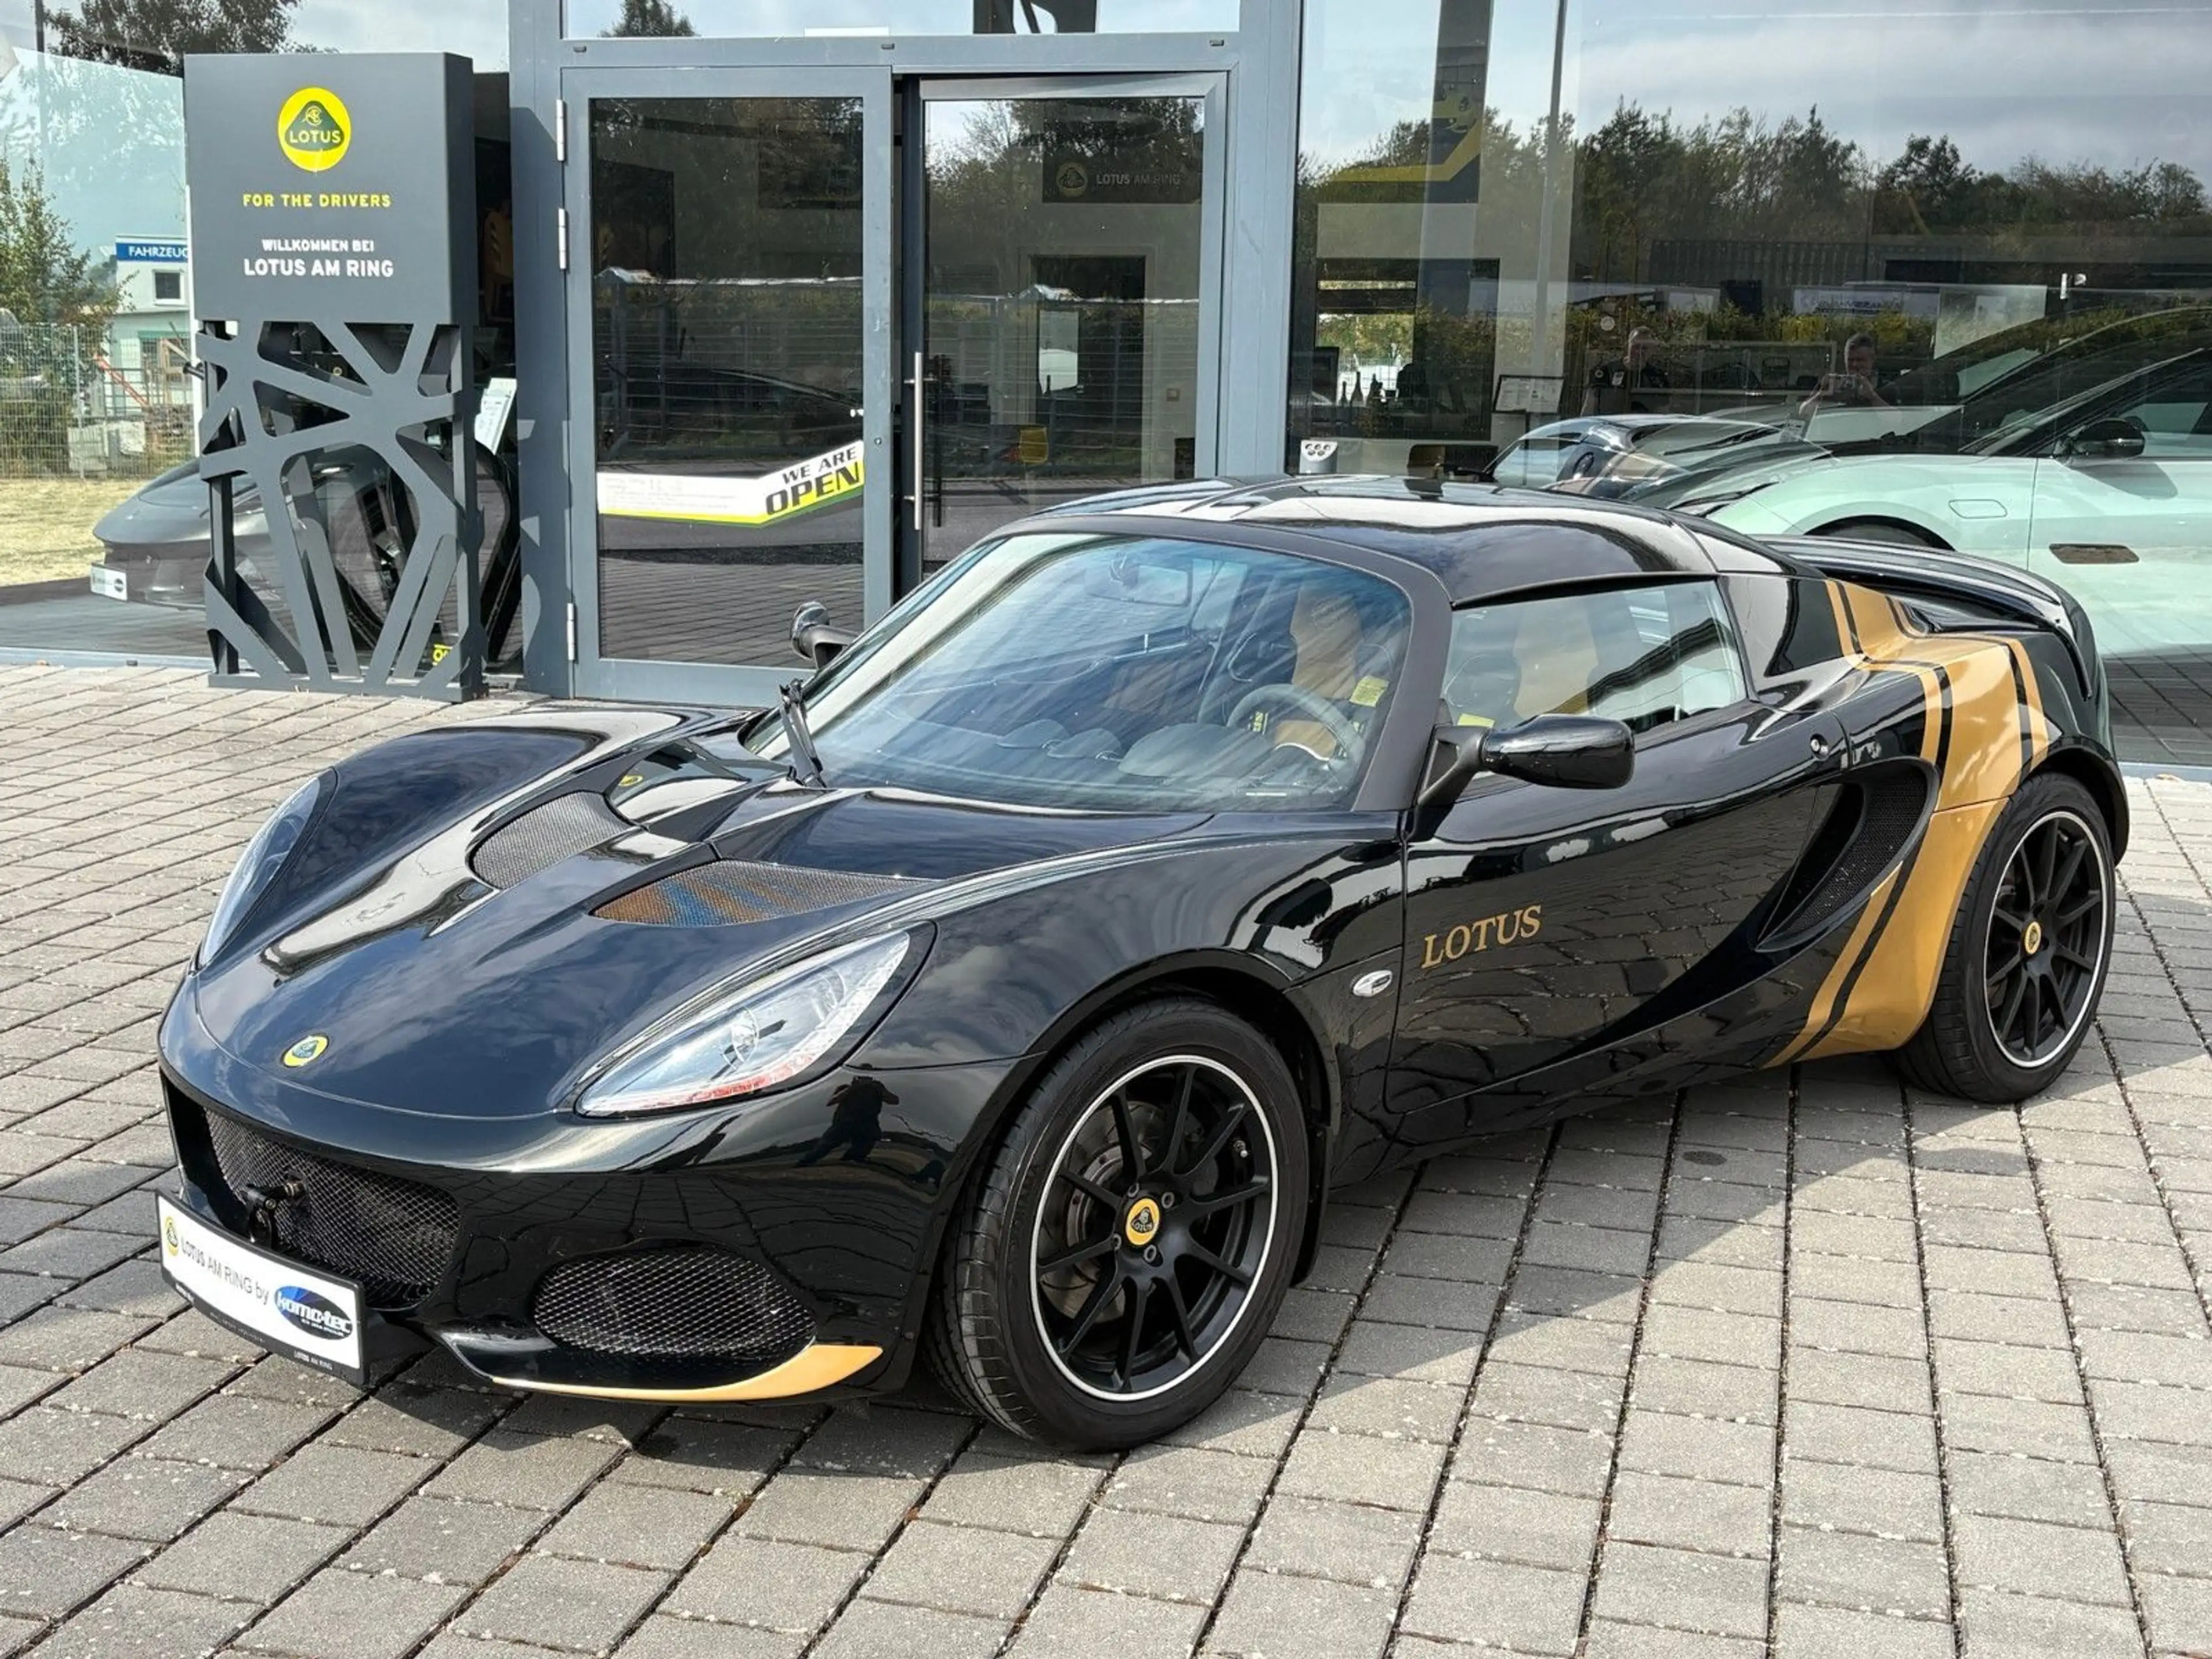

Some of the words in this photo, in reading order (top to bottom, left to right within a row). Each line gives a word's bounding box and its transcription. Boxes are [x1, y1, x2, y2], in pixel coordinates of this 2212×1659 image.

[289, 130, 342, 143] LOTUS
[1096, 175, 1130, 185] LOTUS
[243, 194, 275, 207] FOR
[281, 194, 313, 207] THE
[319, 194, 392, 208] DRIVERS
[262, 239, 349, 252] WILLKOMMEN
[352, 240, 374, 252] BEI
[244, 259, 306, 276] LOTUS
[310, 259, 340, 276] AM
[346, 260, 394, 278] RING
[782, 464, 811, 484] WE
[818, 446, 857, 472] ARE
[766, 461, 859, 515] OPEN
[1421, 904, 1541, 968] LOTUS
[181, 1236, 206, 1267] LOTUS
[207, 1256, 222, 1278] AM
[224, 1265, 253, 1294] RING
[255, 1281, 269, 1306] by
